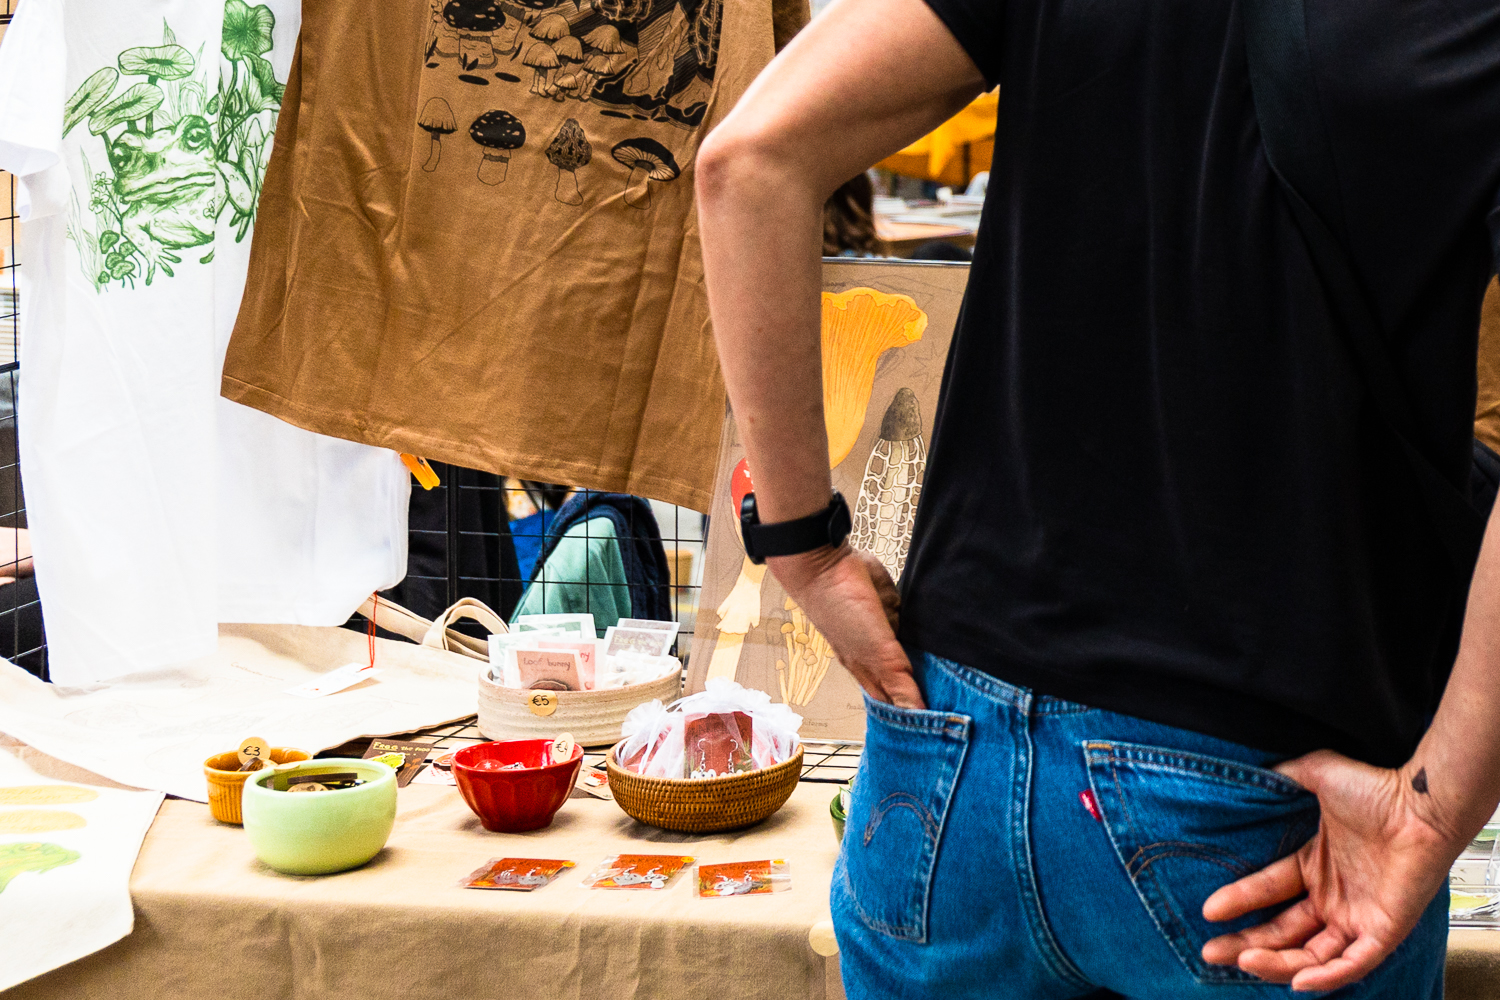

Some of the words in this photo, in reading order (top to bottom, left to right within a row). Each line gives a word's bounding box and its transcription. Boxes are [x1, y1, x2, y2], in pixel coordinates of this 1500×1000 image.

[547, 659, 571, 671] bunny
[532, 694, 550, 707] €5
[243, 745, 261, 757] €3
